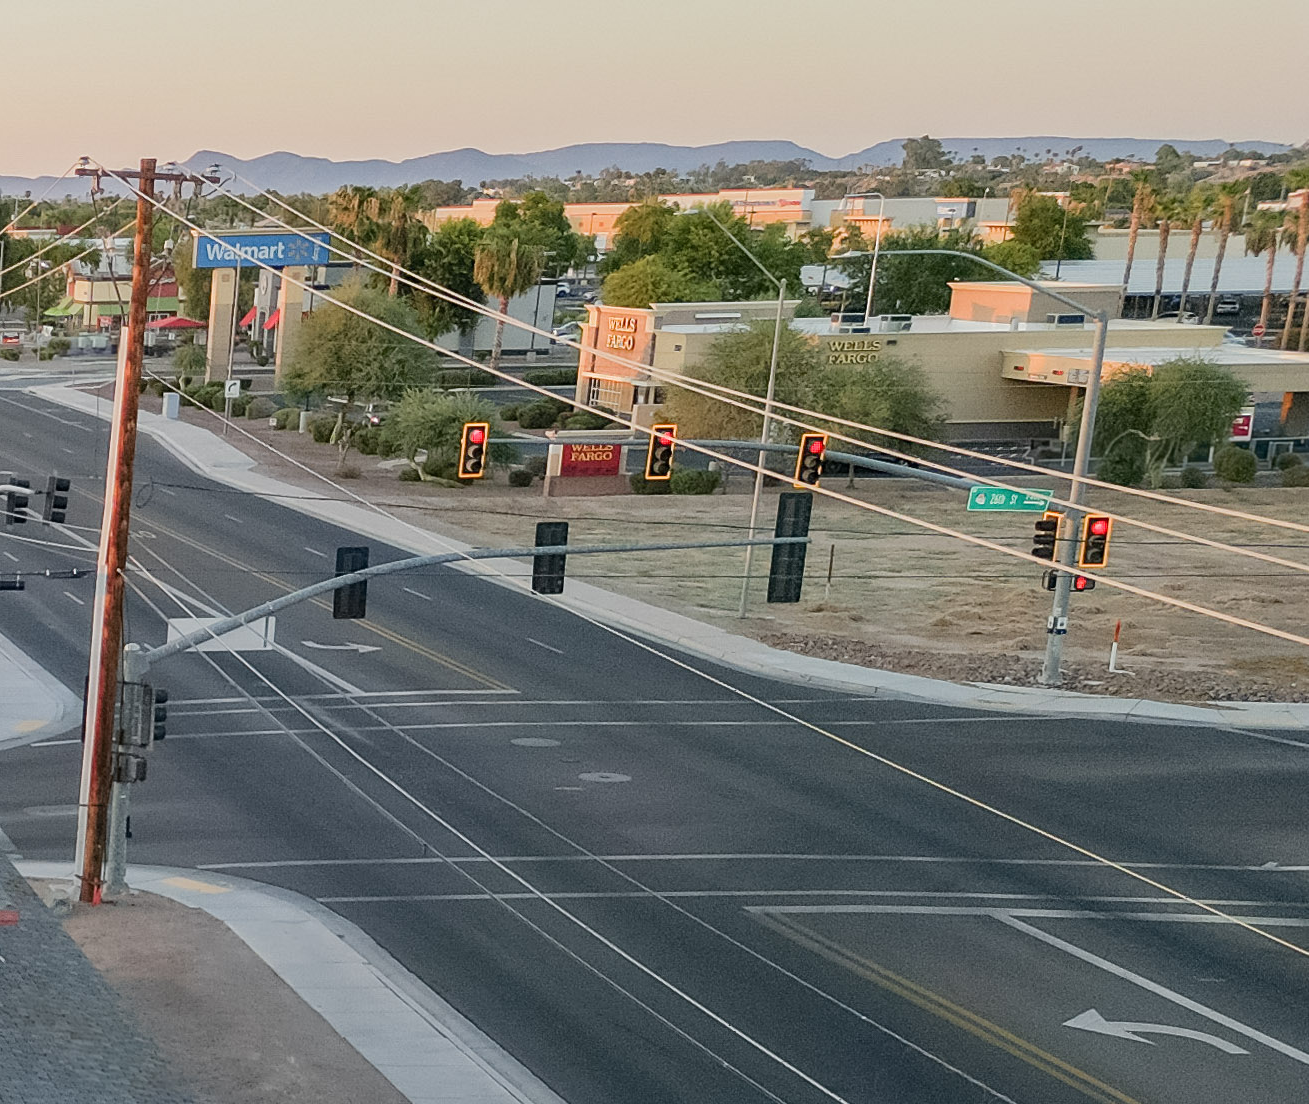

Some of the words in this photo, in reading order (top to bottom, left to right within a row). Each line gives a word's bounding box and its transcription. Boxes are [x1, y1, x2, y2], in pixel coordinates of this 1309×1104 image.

[206, 242, 285, 261] Walmart
[608, 317, 637, 332] WELLS
[606, 334, 634, 350] FARGO
[828, 340, 882, 351] WELLS
[828, 353, 879, 364] FARGO
[571, 443, 614, 452] WELLS
[570, 452, 613, 462] FARGO
